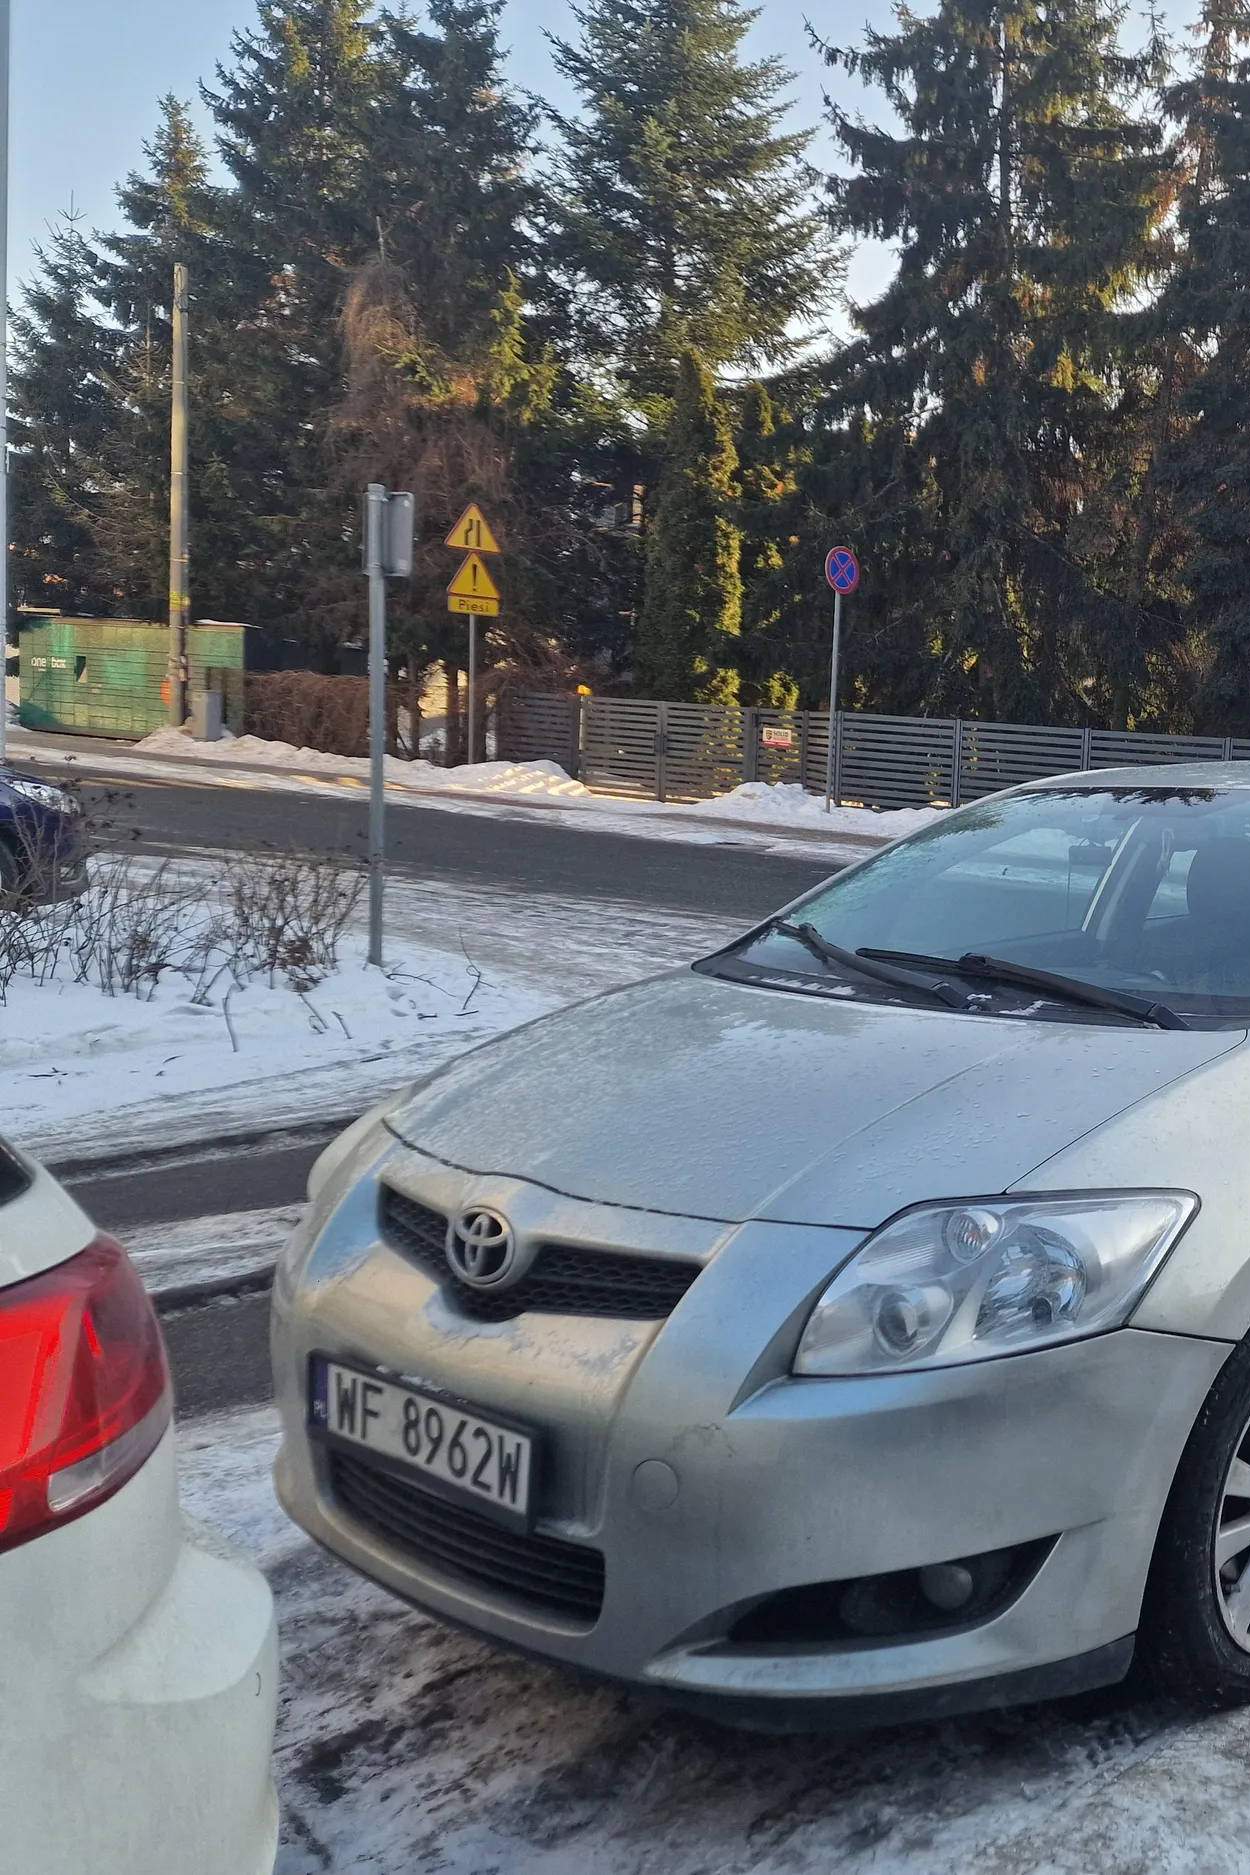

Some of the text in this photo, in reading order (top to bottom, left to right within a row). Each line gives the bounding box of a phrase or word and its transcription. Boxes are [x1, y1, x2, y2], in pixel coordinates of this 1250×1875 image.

[458, 599, 489, 613] Piesi
[31, 656, 47, 667] one
[335, 1372, 521, 1505] WF 8962W
